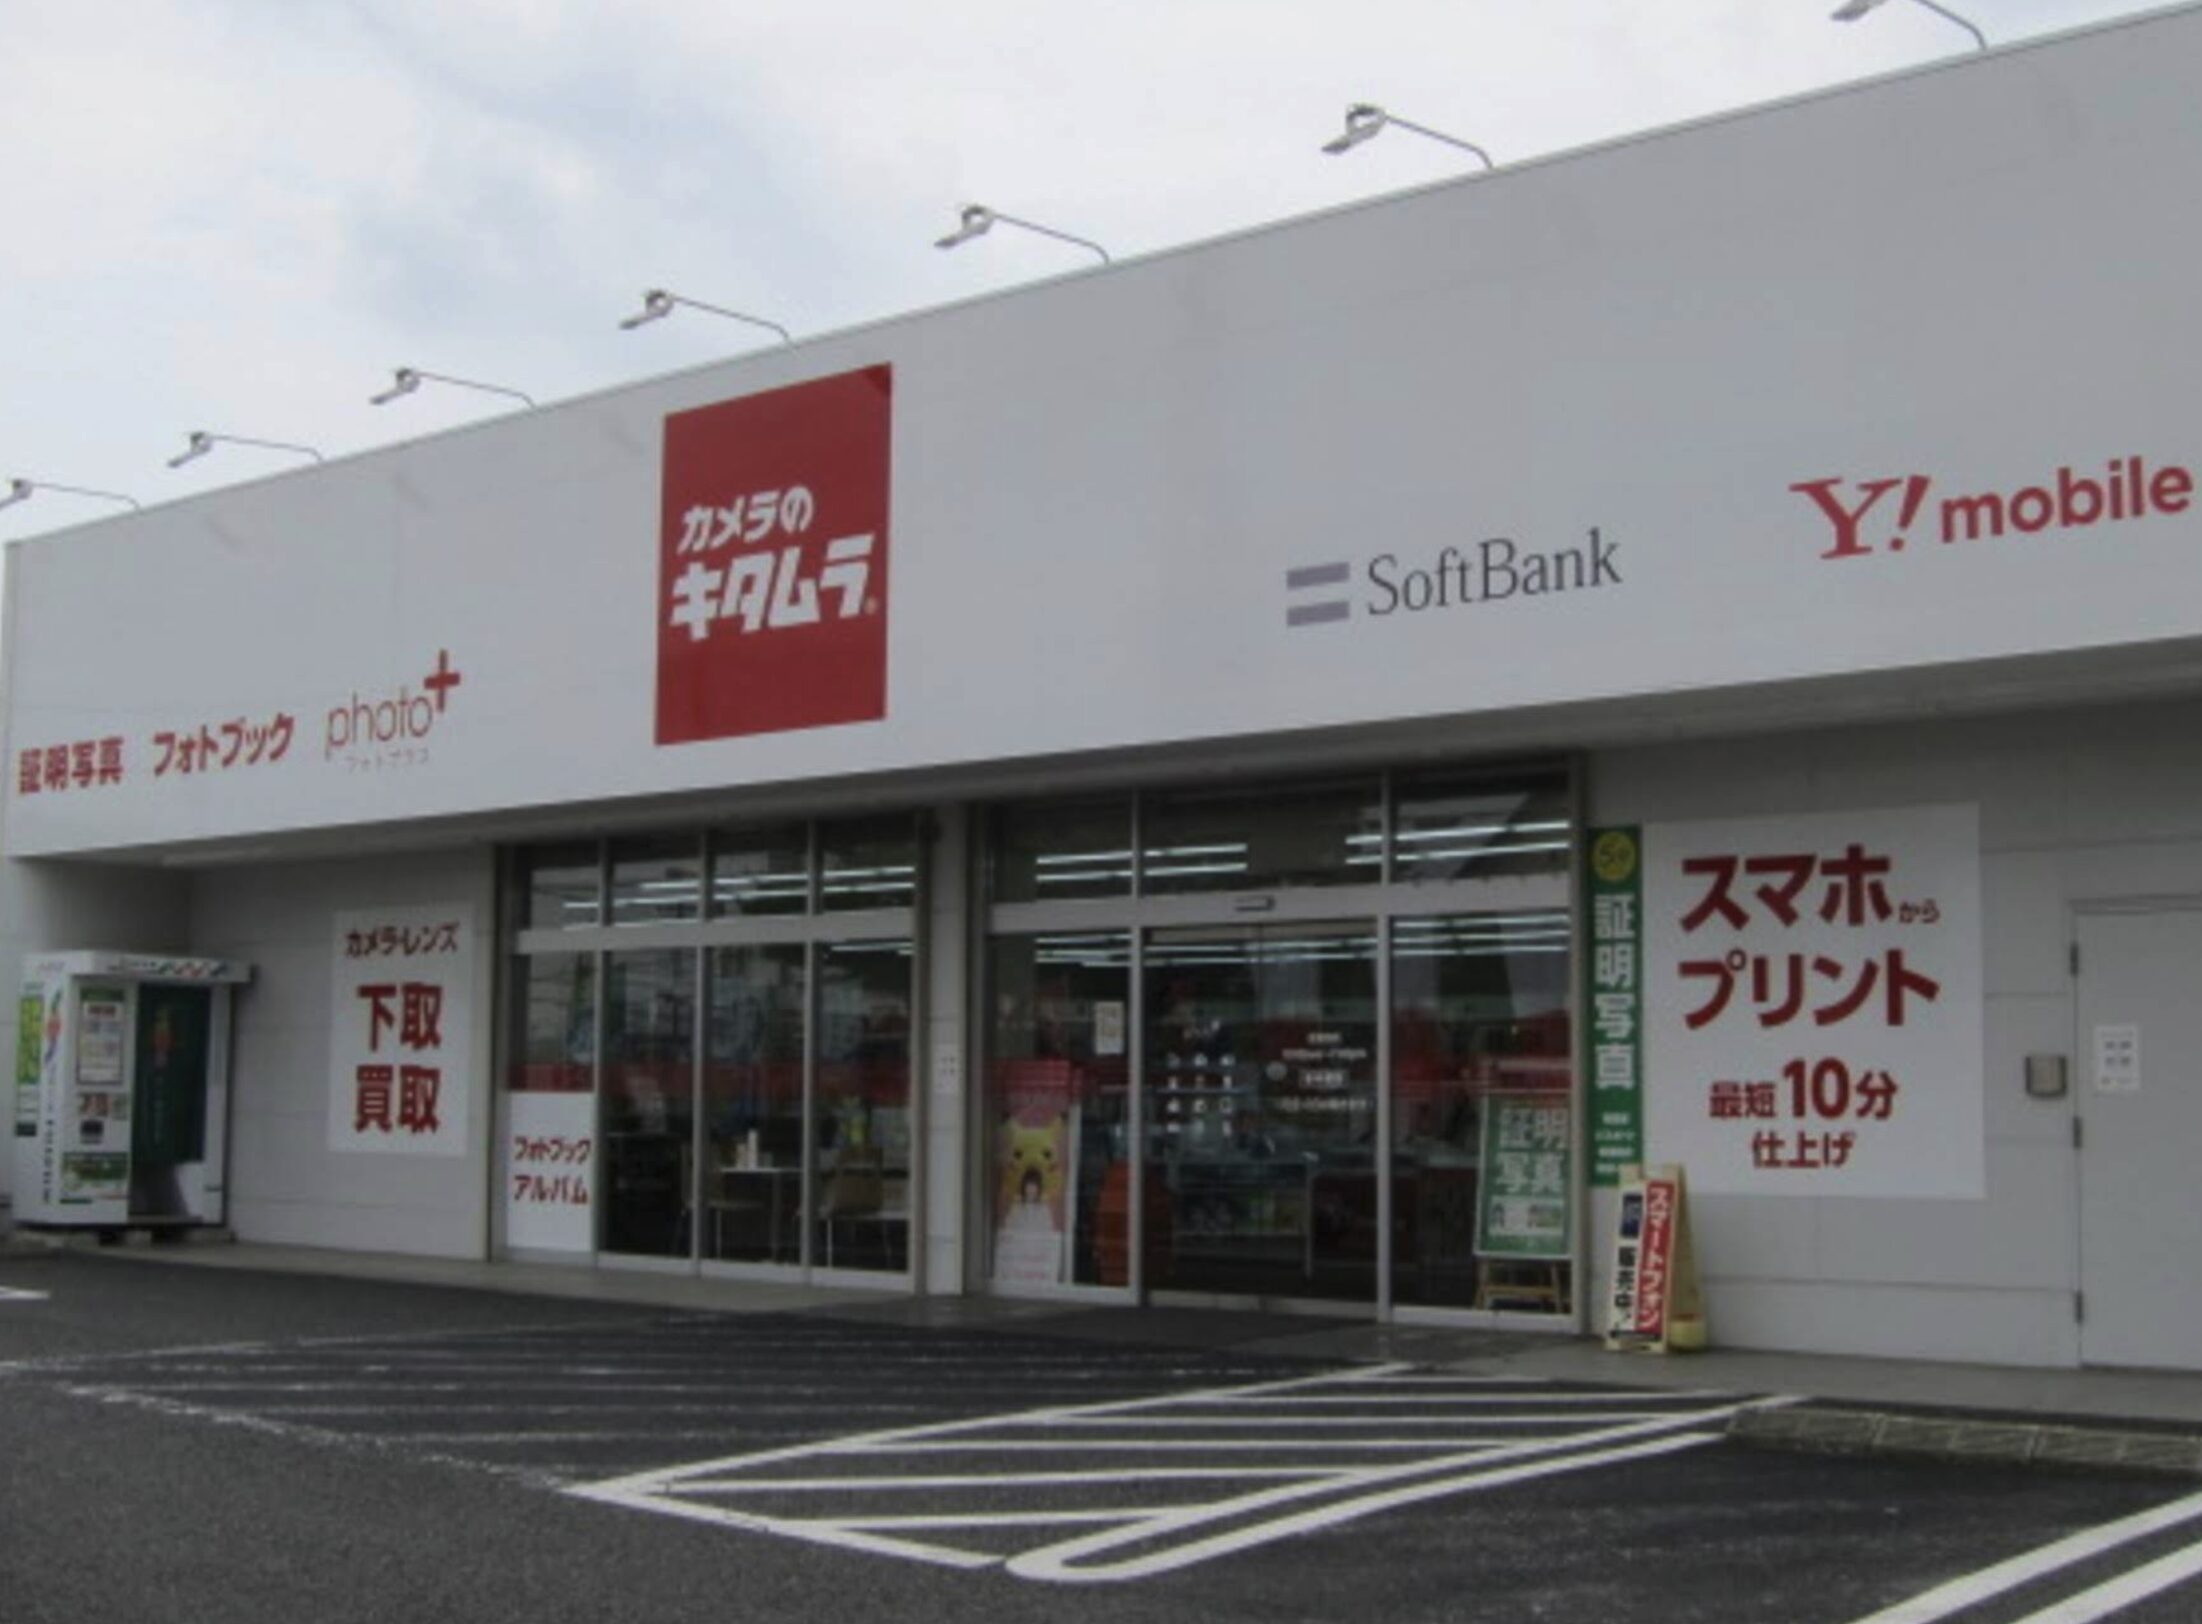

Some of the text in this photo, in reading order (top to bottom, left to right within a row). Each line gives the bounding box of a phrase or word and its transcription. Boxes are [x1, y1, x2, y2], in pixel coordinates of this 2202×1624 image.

[677, 486, 815, 556] カメラの
[1788, 455, 2194, 560] Y! mobile
[670, 532, 875, 642] キタムラ
[1366, 526, 1623, 617] SoftBank
[19, 713, 295, 794] 証明写真 フォトブック
[357, 981, 442, 1050] 下取
[1594, 893, 1635, 1089] 証明写真
[1678, 948, 1941, 1030] プリント
[355, 1064, 441, 1133] 買取
[514, 1175, 588, 1205] アルバム
[1751, 1130, 1858, 1169] 仕上げ
